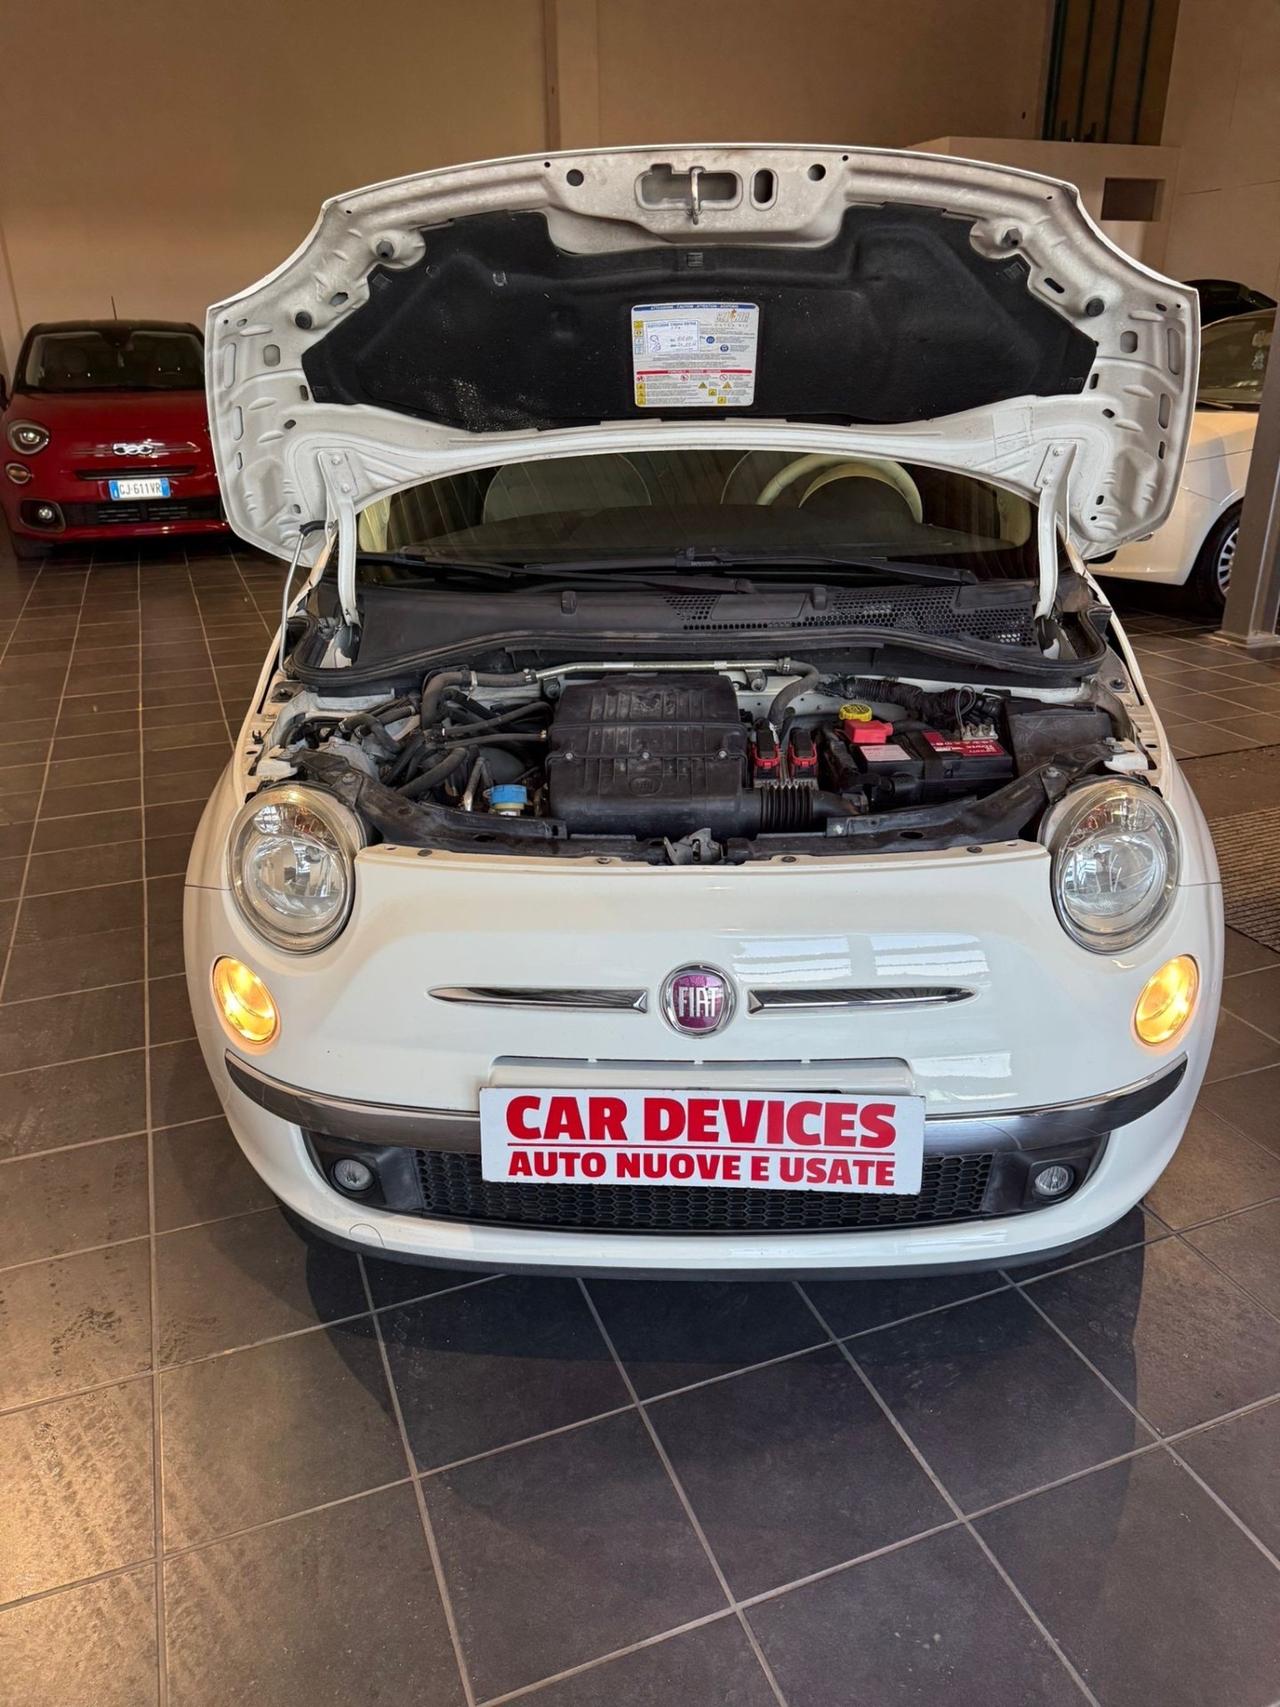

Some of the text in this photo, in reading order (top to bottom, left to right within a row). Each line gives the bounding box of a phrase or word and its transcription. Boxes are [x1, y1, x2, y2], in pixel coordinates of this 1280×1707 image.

[678, 986, 720, 1018] FIAT
[505, 1095, 896, 1149] CAR DEVICES
[508, 1151, 896, 1187] AUTO NUOVE E USATE
